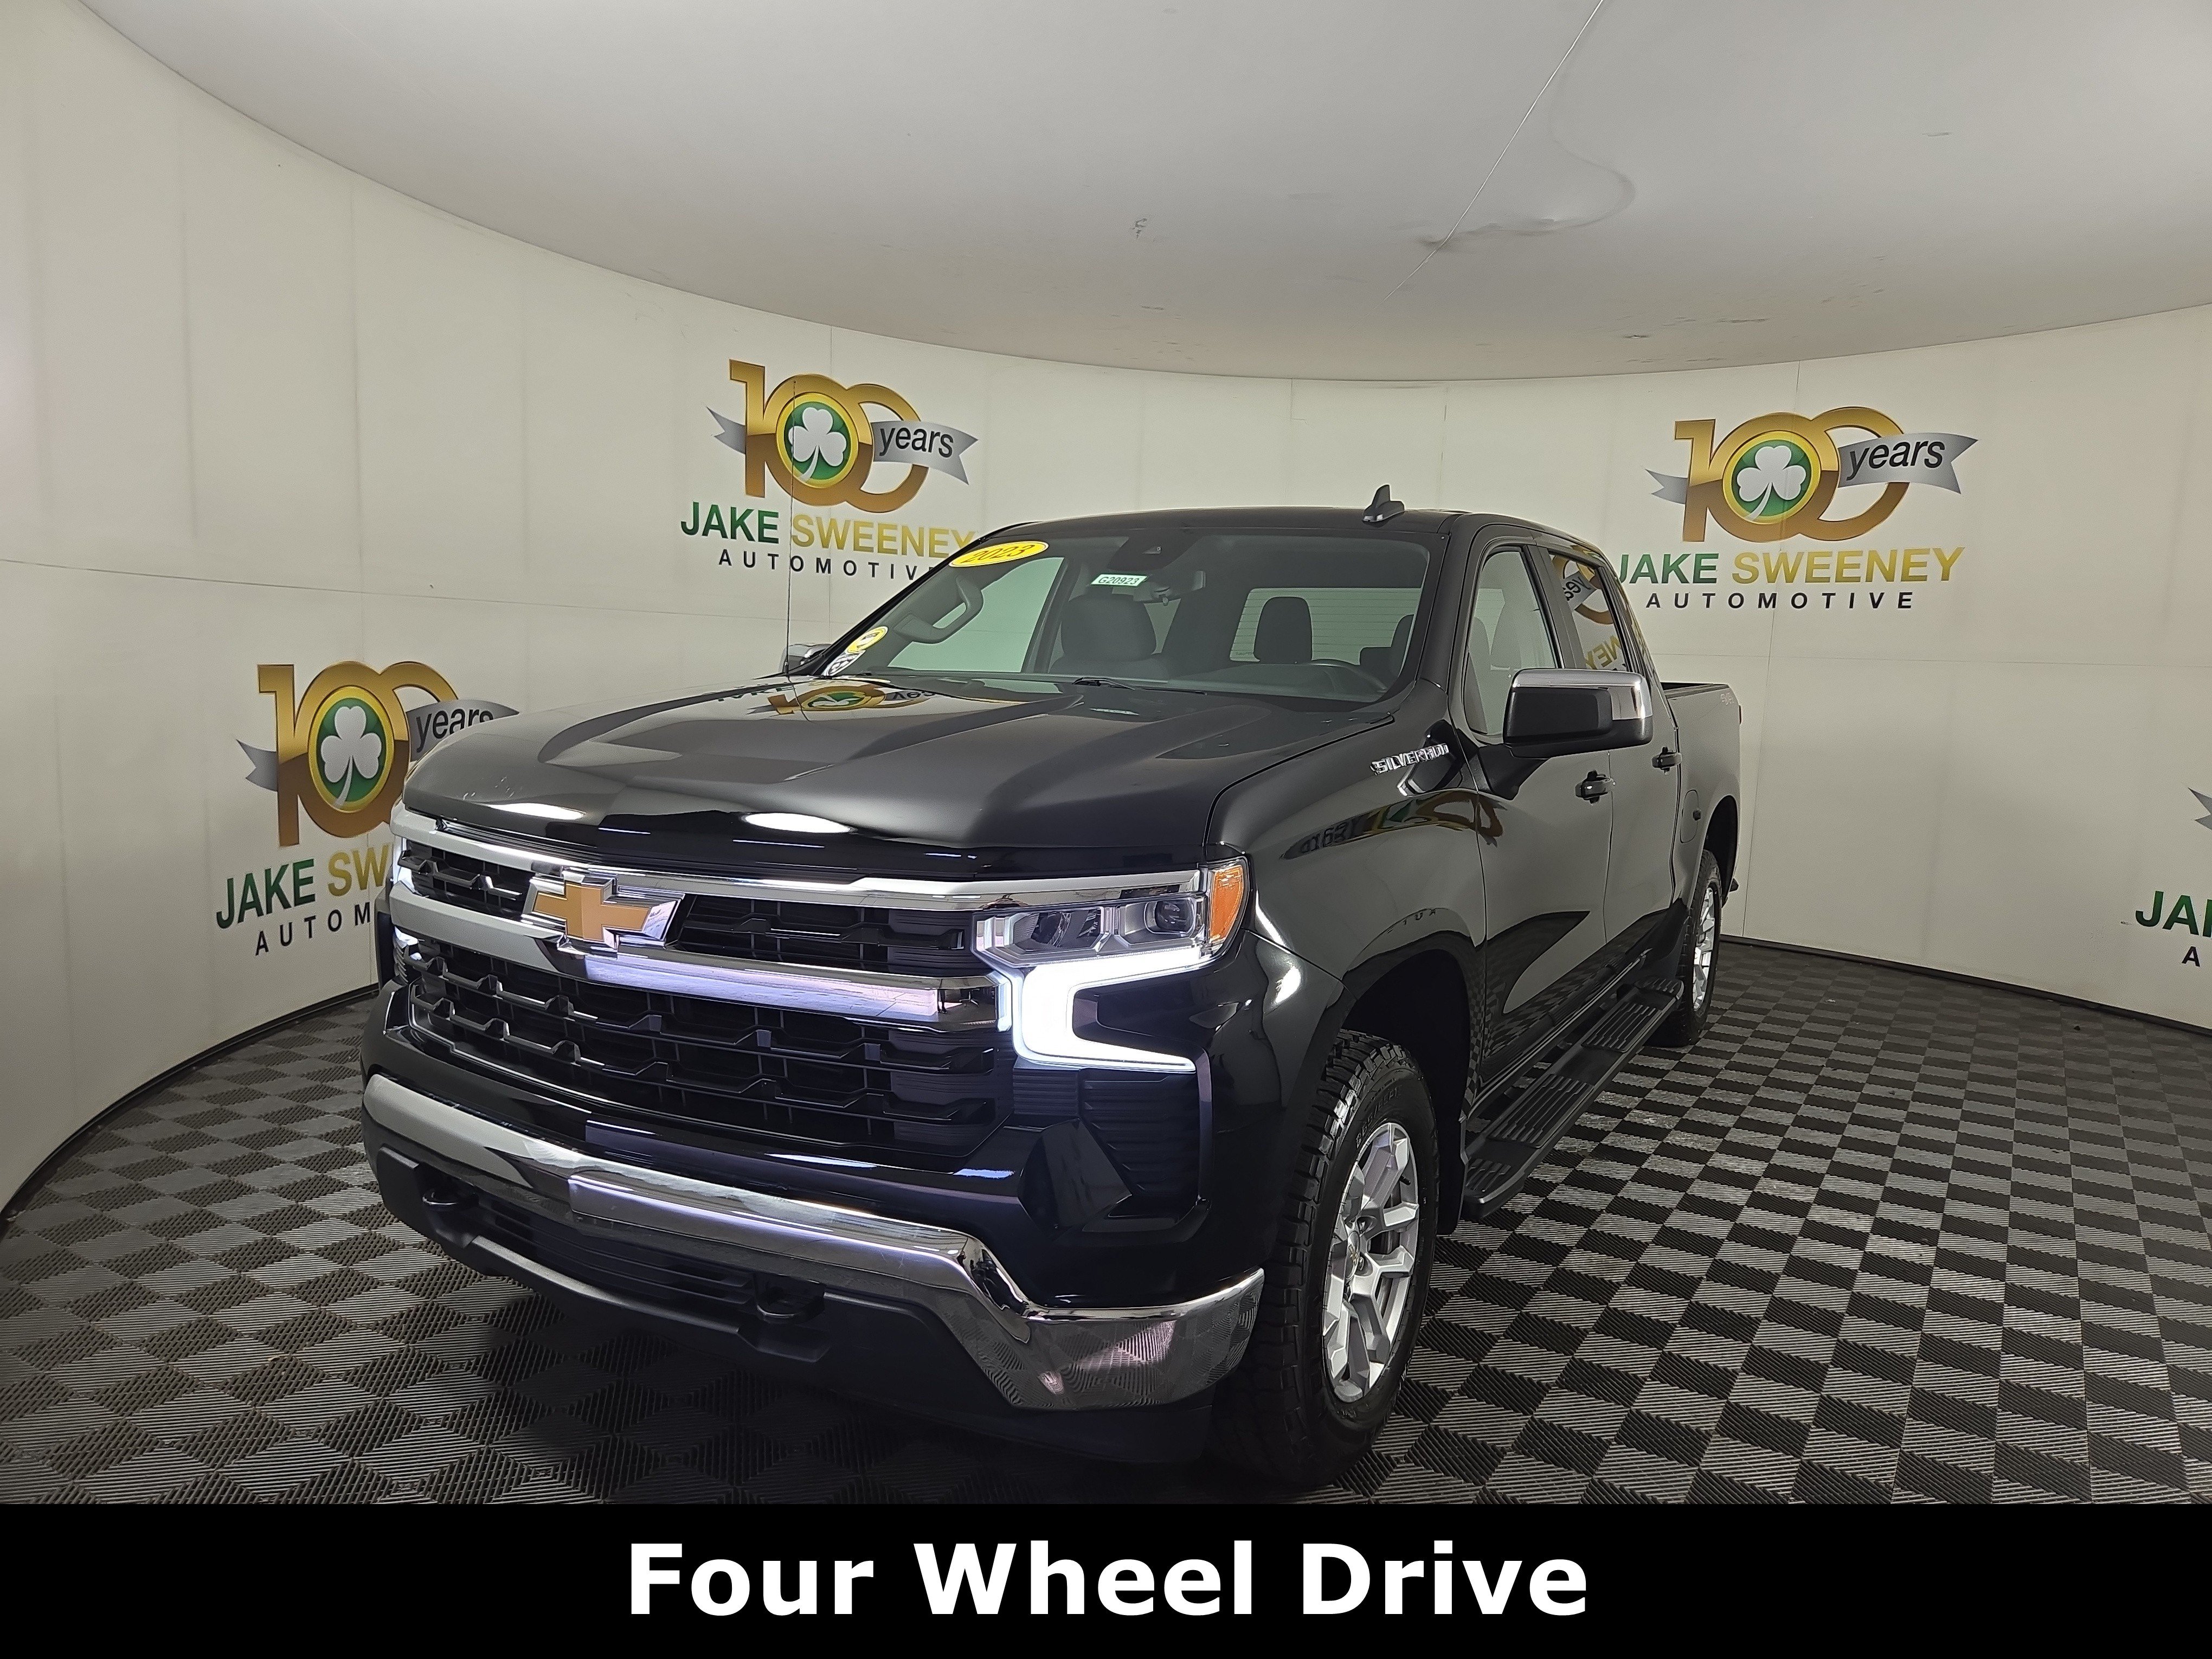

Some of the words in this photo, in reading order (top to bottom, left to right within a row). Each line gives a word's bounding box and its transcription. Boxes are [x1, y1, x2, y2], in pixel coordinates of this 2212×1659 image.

[729, 359, 929, 513] 100
[879, 423, 954, 458] years
[1674, 406, 1910, 543] 100
[1846, 439, 1946, 481] years
[681, 501, 780, 544] JAKE
[792, 513, 975, 558] SWEENEY
[719, 548, 934, 581] AUTOMOTIV
[960, 544, 1036, 564] 2023
[1619, 553, 1719, 584] JAKE
[1732, 547, 1966, 584] SWEENEY
[1098, 576, 1139, 586] G20923
[1646, 591, 1913, 609] AUTOMOTIVE
[216, 858, 316, 929] JAKE
[2136, 890, 2212, 937] JA
[255, 902, 371, 956] AUTOM
